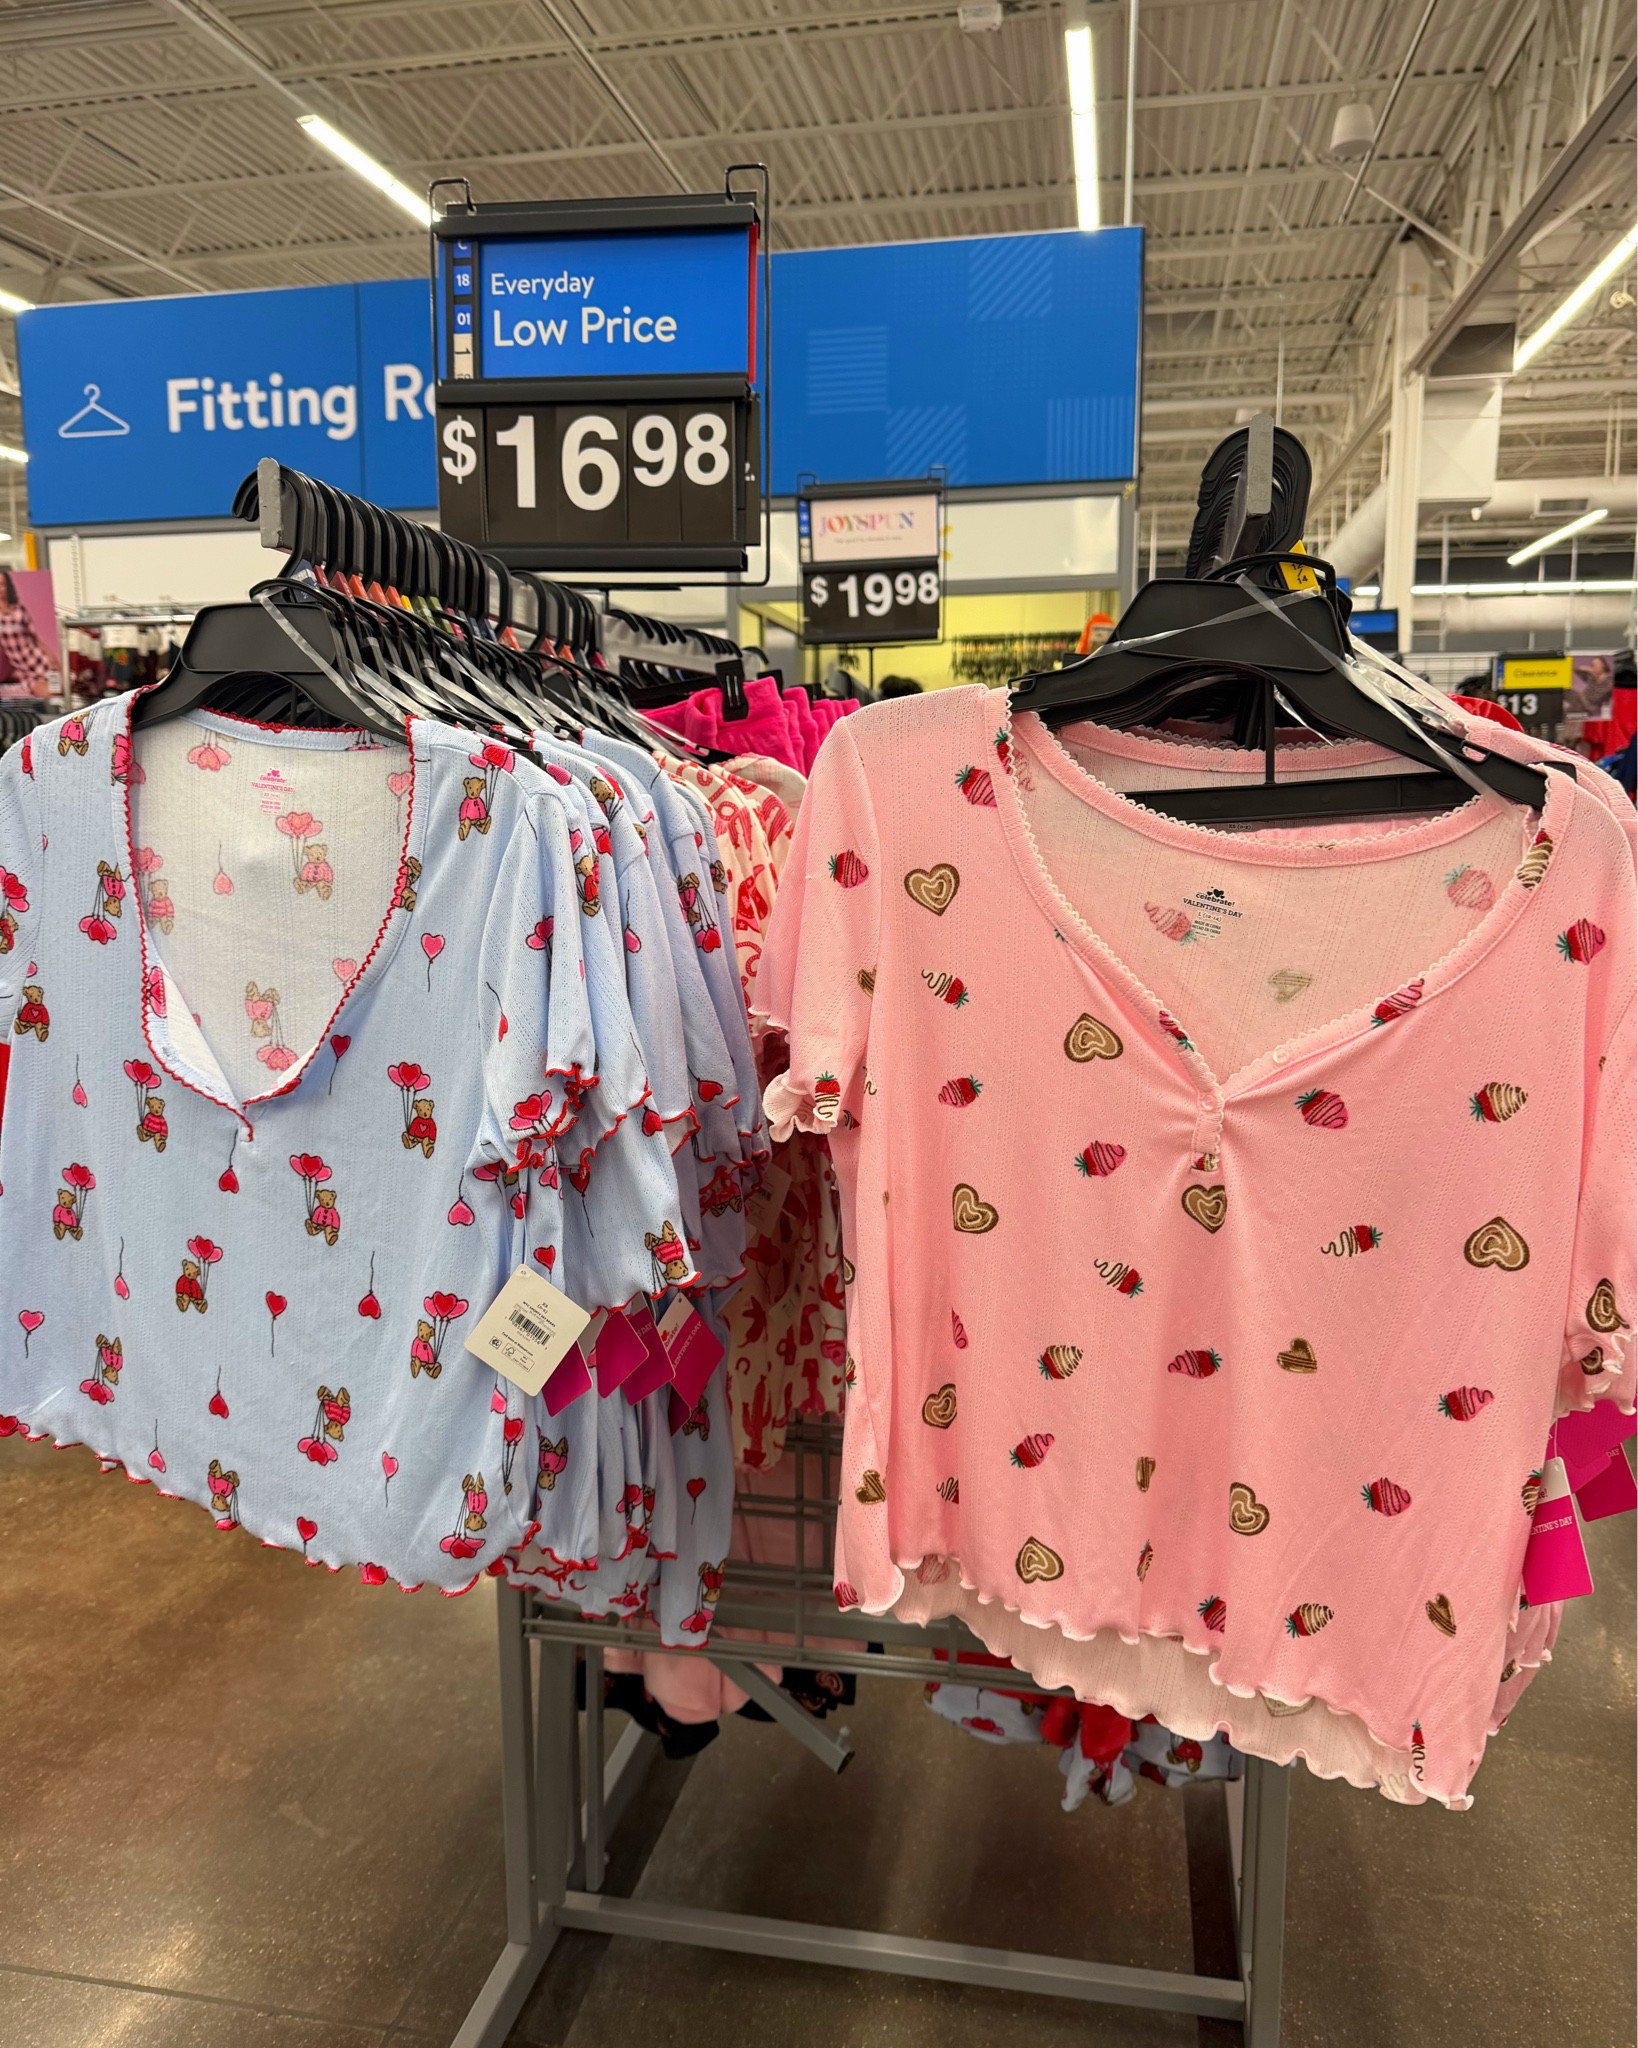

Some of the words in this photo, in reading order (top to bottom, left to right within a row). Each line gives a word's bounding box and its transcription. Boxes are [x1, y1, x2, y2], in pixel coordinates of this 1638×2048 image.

[456, 273, 471, 287] 18
[491, 270, 595, 301] Everyday
[456, 312, 471, 326] 01
[493, 309, 568, 347] Low
[581, 305, 678, 345] Price
[166, 372, 357, 441] Fitting
[1195, 893, 1235, 906] celebrate!
[1183, 898, 1227, 915] VALENTINE'S
[1228, 909, 1243, 919] DAY
[1560, 1516, 1573, 1526] DAY
